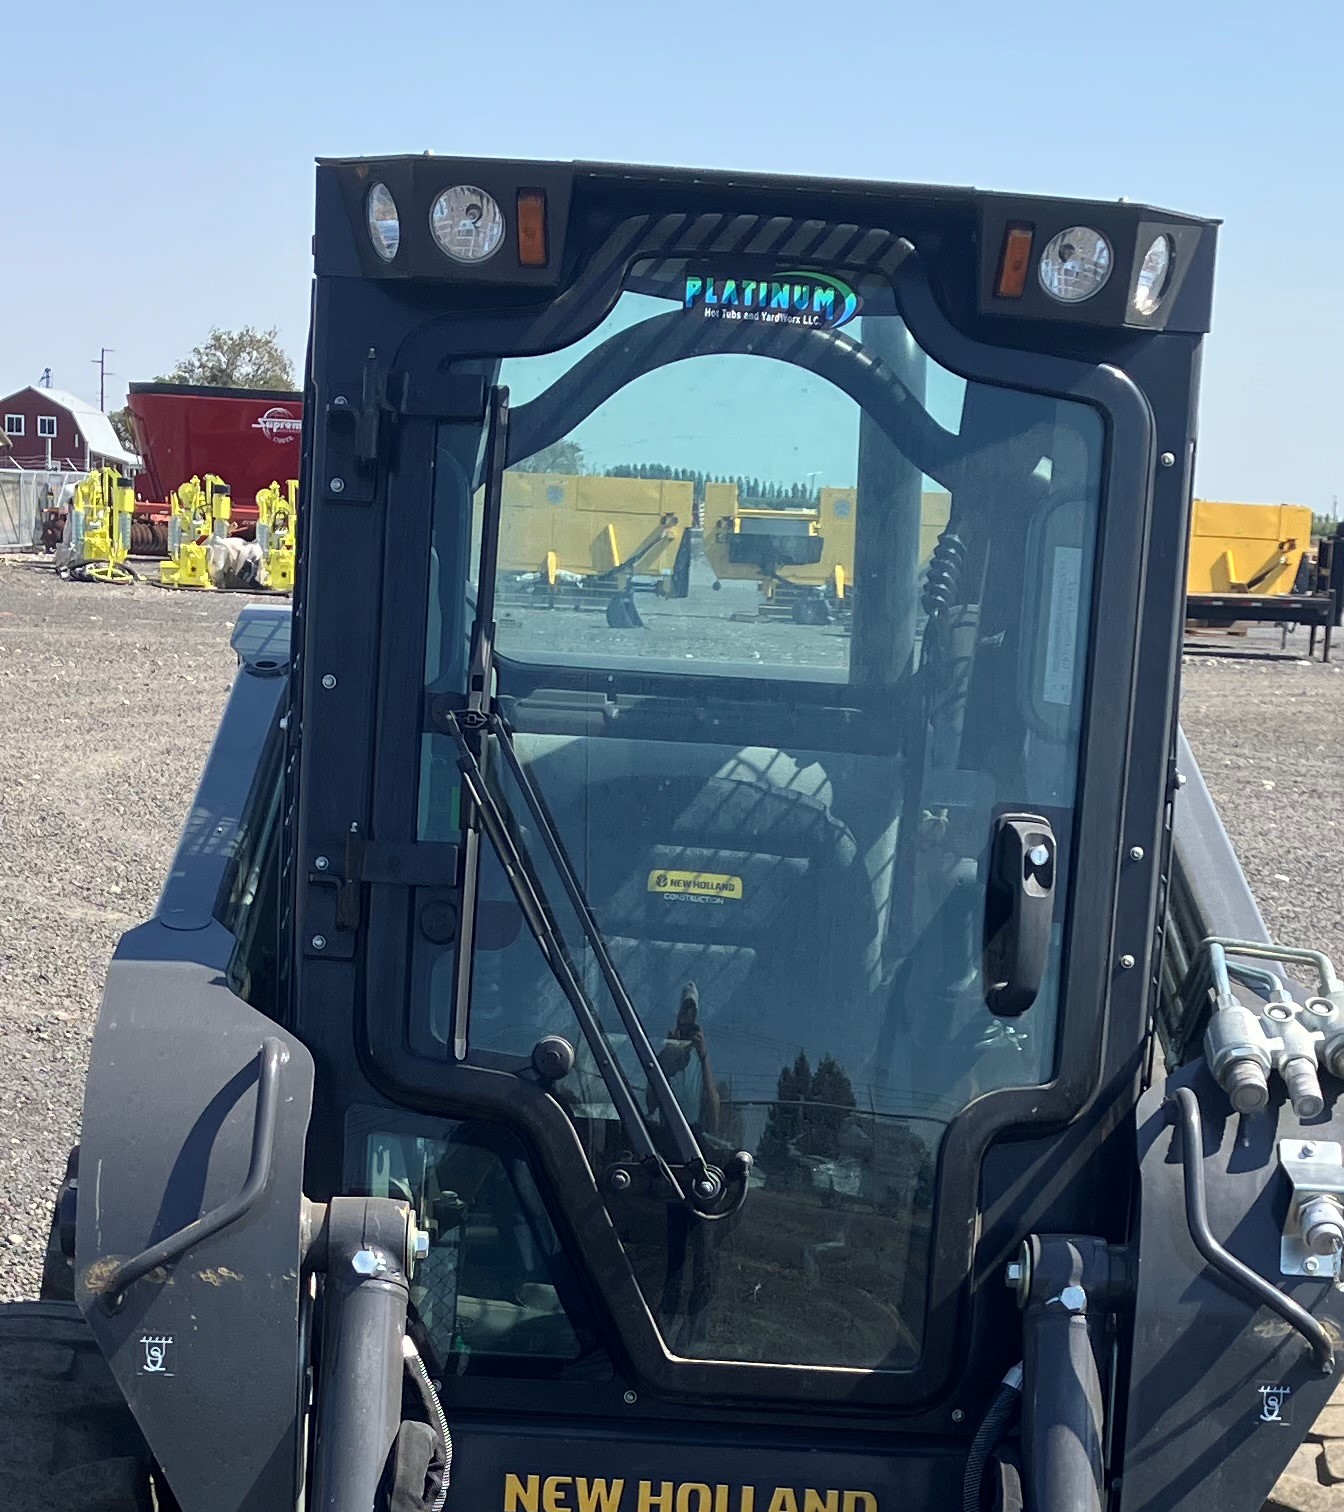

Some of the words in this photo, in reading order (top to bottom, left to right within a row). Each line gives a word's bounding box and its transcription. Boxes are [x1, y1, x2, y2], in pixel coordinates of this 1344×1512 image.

[685, 276, 835, 320] PLATINUM
[704, 307, 720, 318] Hot
[722, 308, 741, 320] Tubs
[743, 311, 760, 320] and
[251, 417, 303, 433] Suprem
[670, 878, 692, 889] NEW
[693, 881, 735, 892] HOLLAND
[663, 892, 724, 905] CONSTRUCTION
